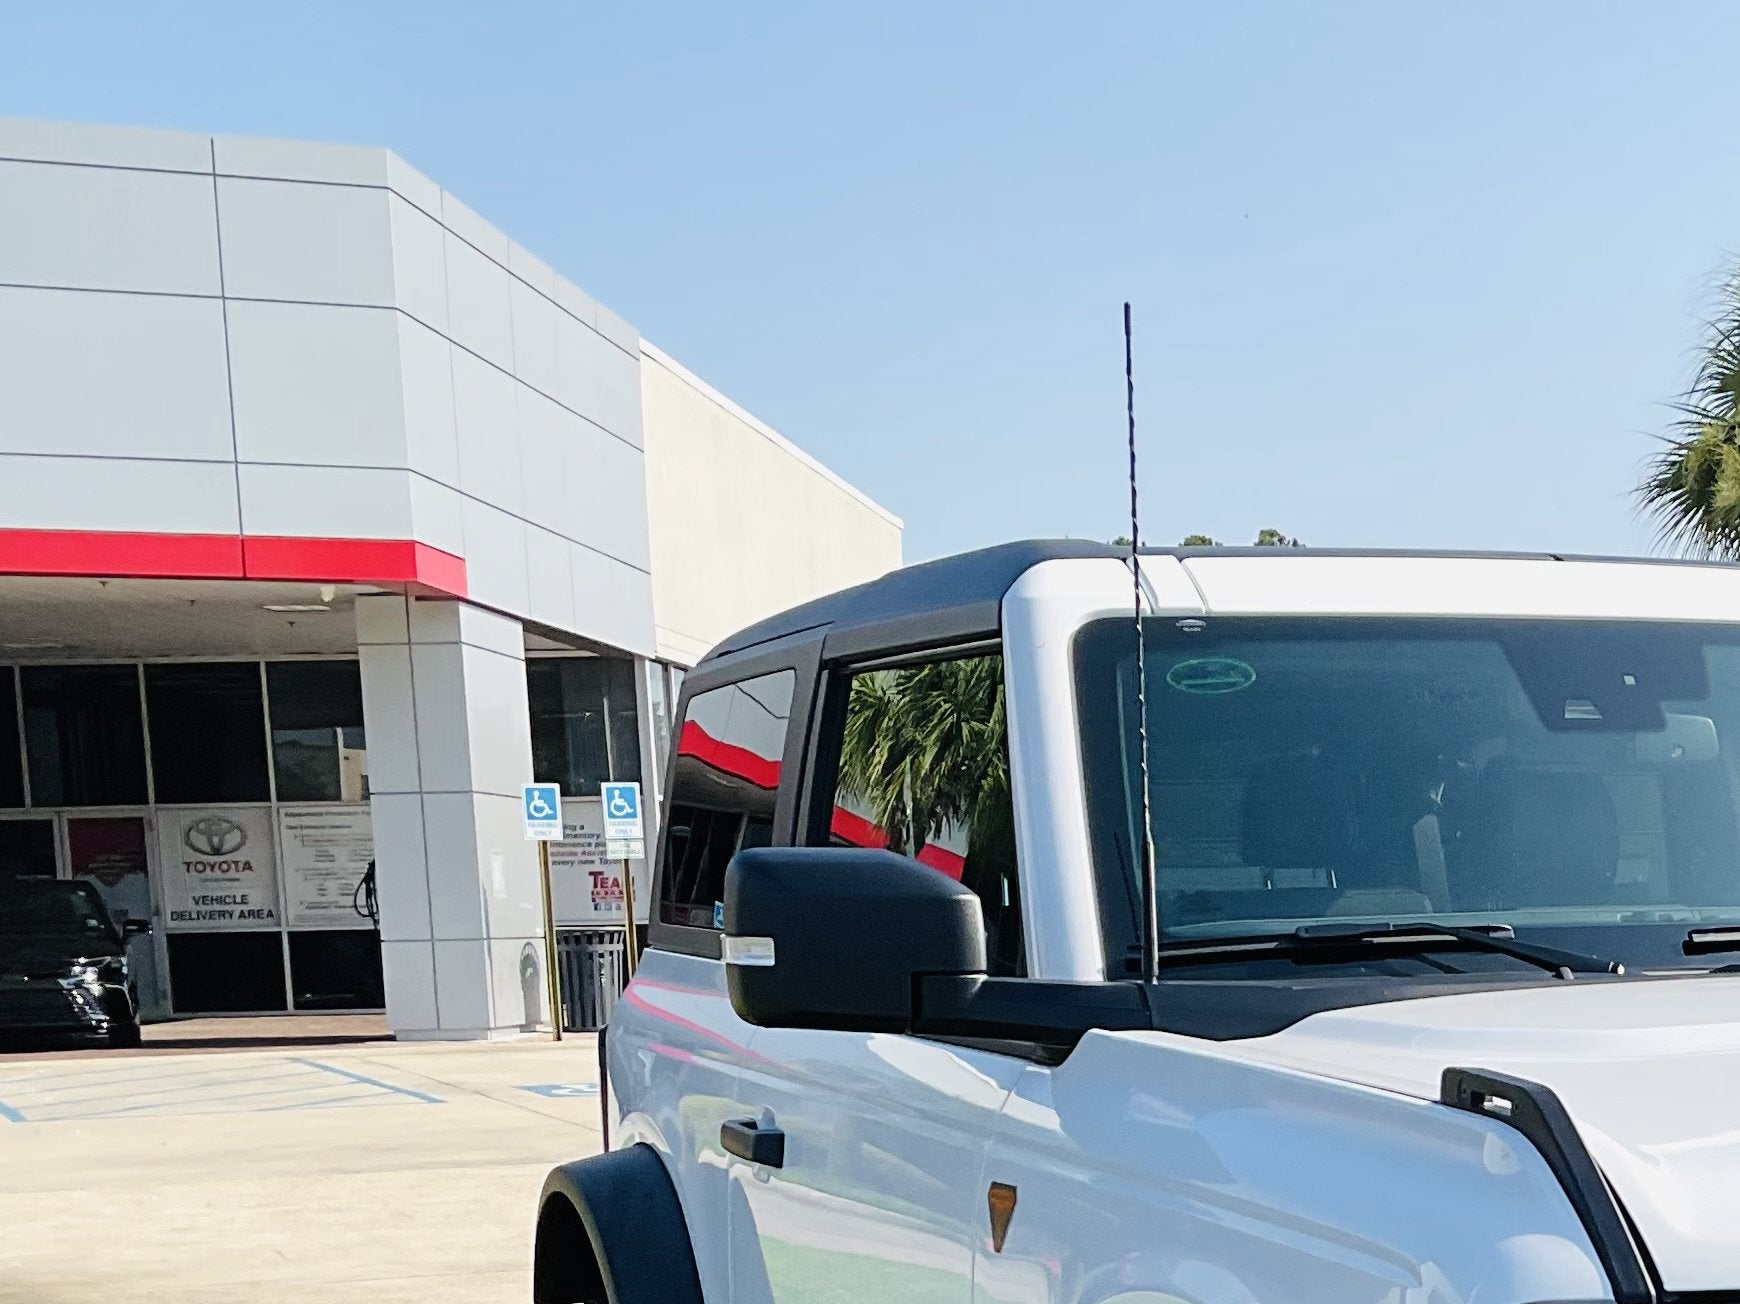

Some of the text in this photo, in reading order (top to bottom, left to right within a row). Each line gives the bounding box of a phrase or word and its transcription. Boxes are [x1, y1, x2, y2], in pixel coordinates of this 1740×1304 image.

[183, 860, 254, 874] TOYOTA
[588, 871, 635, 889] TEA
[192, 894, 249, 906] VEHICLE
[170, 908, 275, 922] DELIVERY AREA
